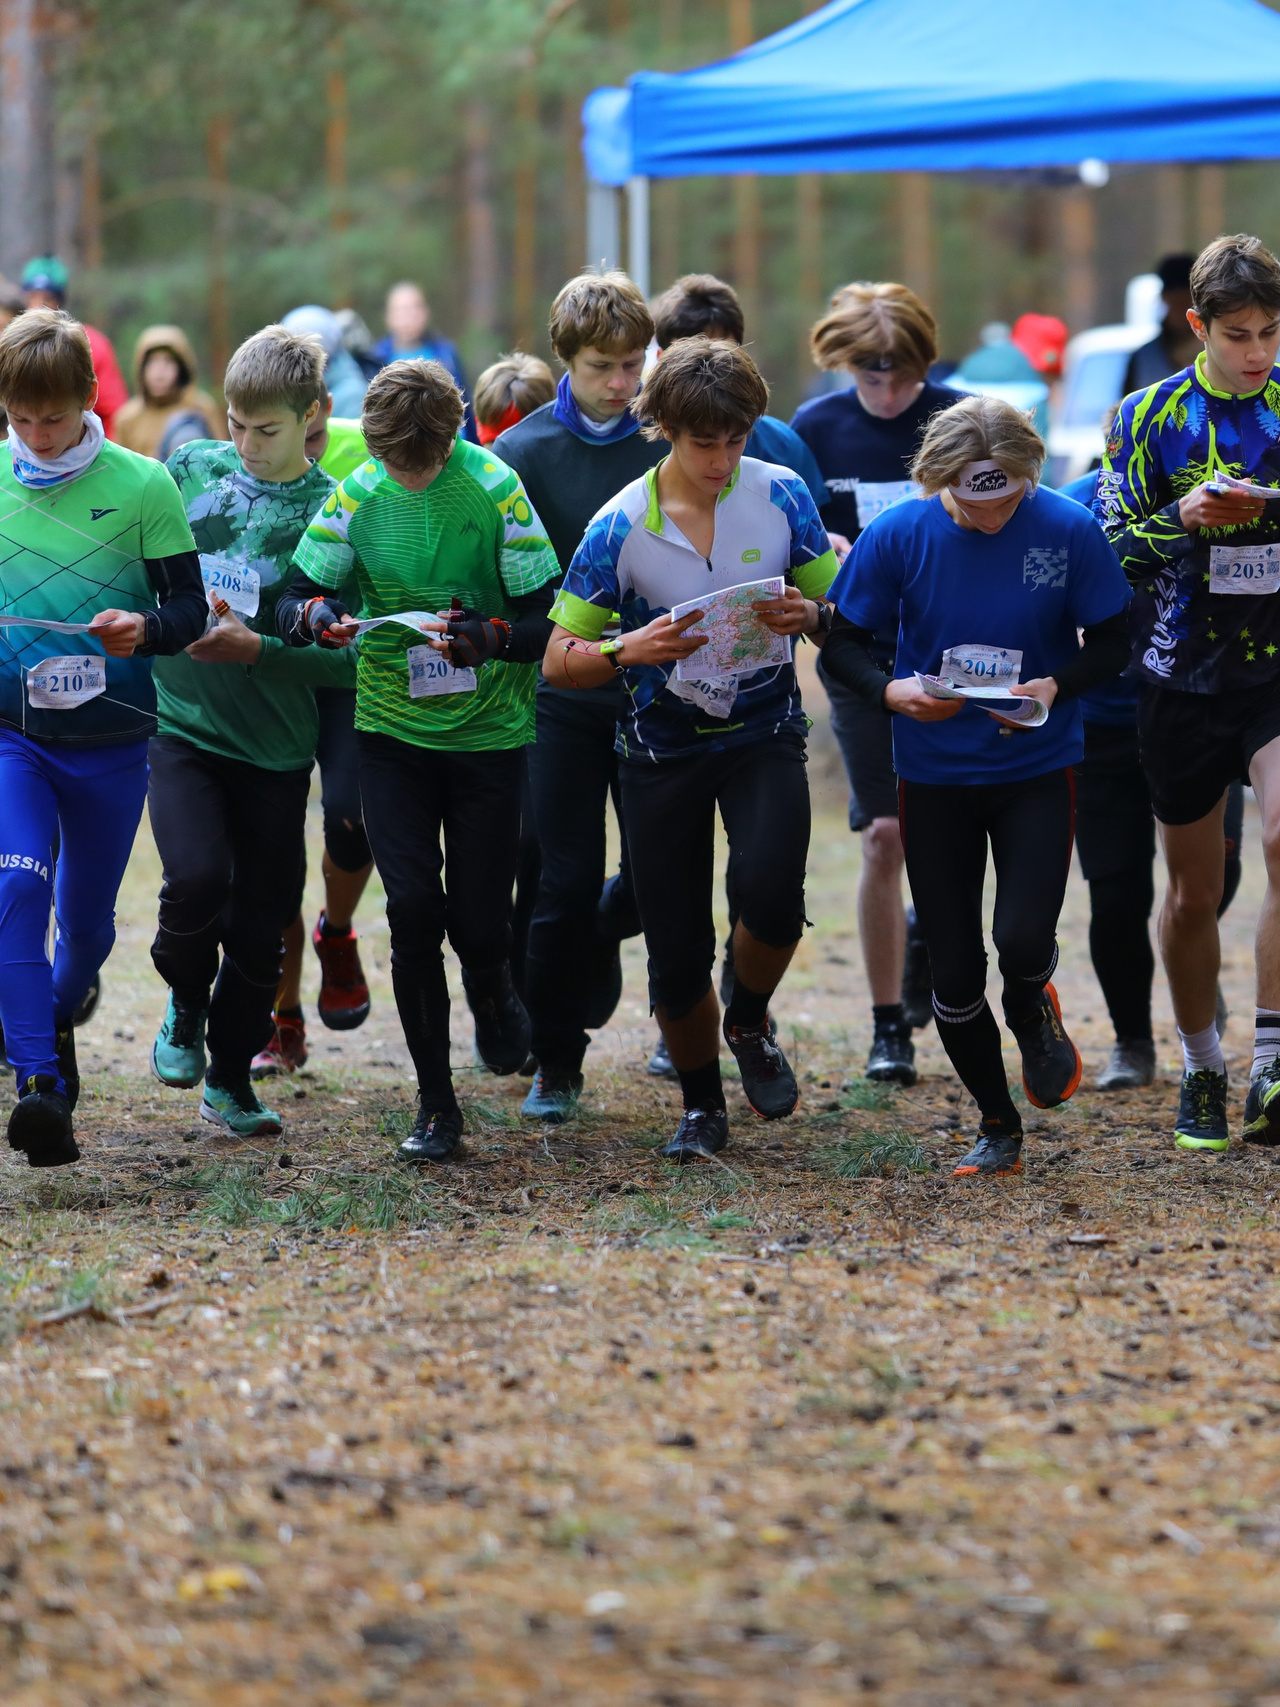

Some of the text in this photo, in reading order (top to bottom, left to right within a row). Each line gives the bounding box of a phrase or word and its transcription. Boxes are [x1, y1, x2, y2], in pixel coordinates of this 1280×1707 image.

[1231, 562, 1265, 579] 203
[210, 571, 241, 593] 208
[963, 659, 997, 678] 204
[49, 674, 83, 693] 210
[690, 679, 722, 701] 205
